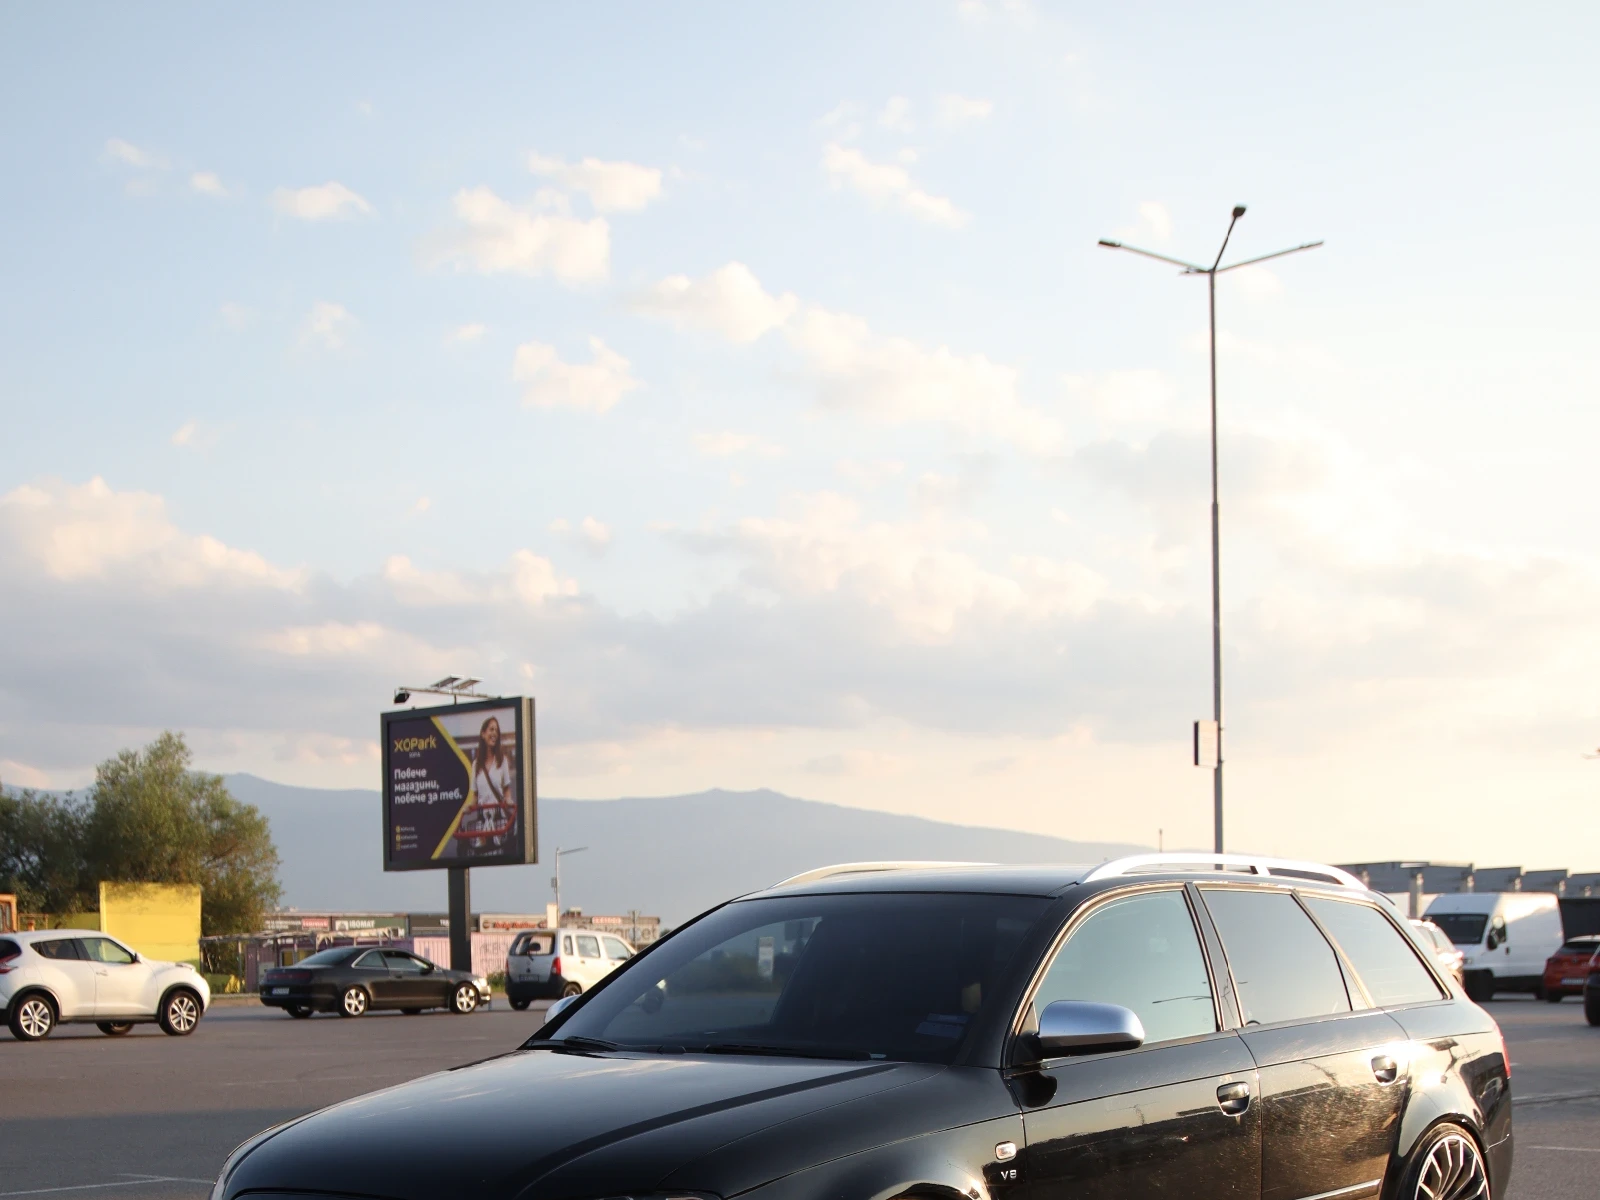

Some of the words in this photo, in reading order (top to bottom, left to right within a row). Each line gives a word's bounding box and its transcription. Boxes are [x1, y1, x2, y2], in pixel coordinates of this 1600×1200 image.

[394, 767, 427, 780] Повече
[394, 780, 440, 793] магазини,
[394, 793, 426, 805] повече
[427, 792, 438, 804] за
[440, 788, 462, 801] теб.
[1000, 1169, 1017, 1180] V8
